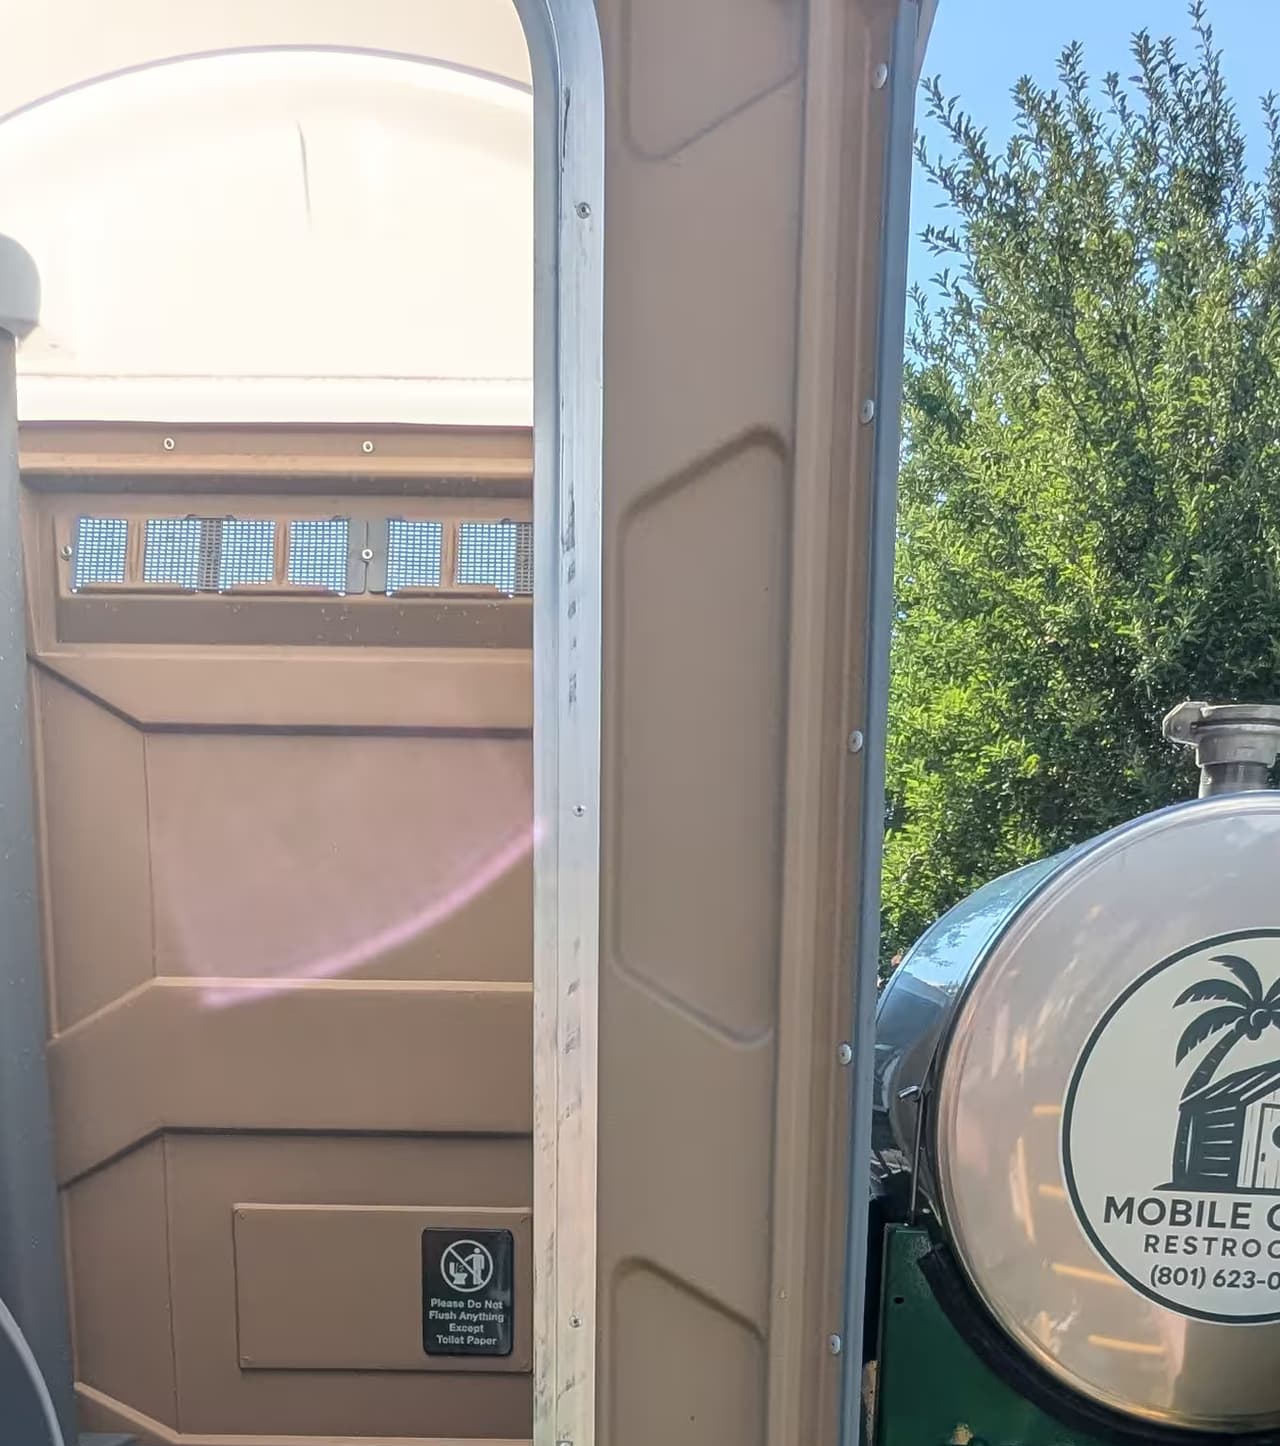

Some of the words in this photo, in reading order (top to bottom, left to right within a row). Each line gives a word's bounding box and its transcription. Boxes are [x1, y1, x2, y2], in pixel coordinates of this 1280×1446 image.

[1103, 1195, 1252, 1230] MOBILE
[1150, 1264, 1207, 1290] (801)
[430, 1298, 465, 1308] Please
[467, 1299, 482, 1309] Do
[484, 1300, 503, 1310] Not
[429, 1310, 457, 1320] Flush
[459, 1311, 504, 1323] Anything
[449, 1323, 484, 1334] Except
[436, 1335, 464, 1345] Toilet
[467, 1336, 497, 1346] Paper
